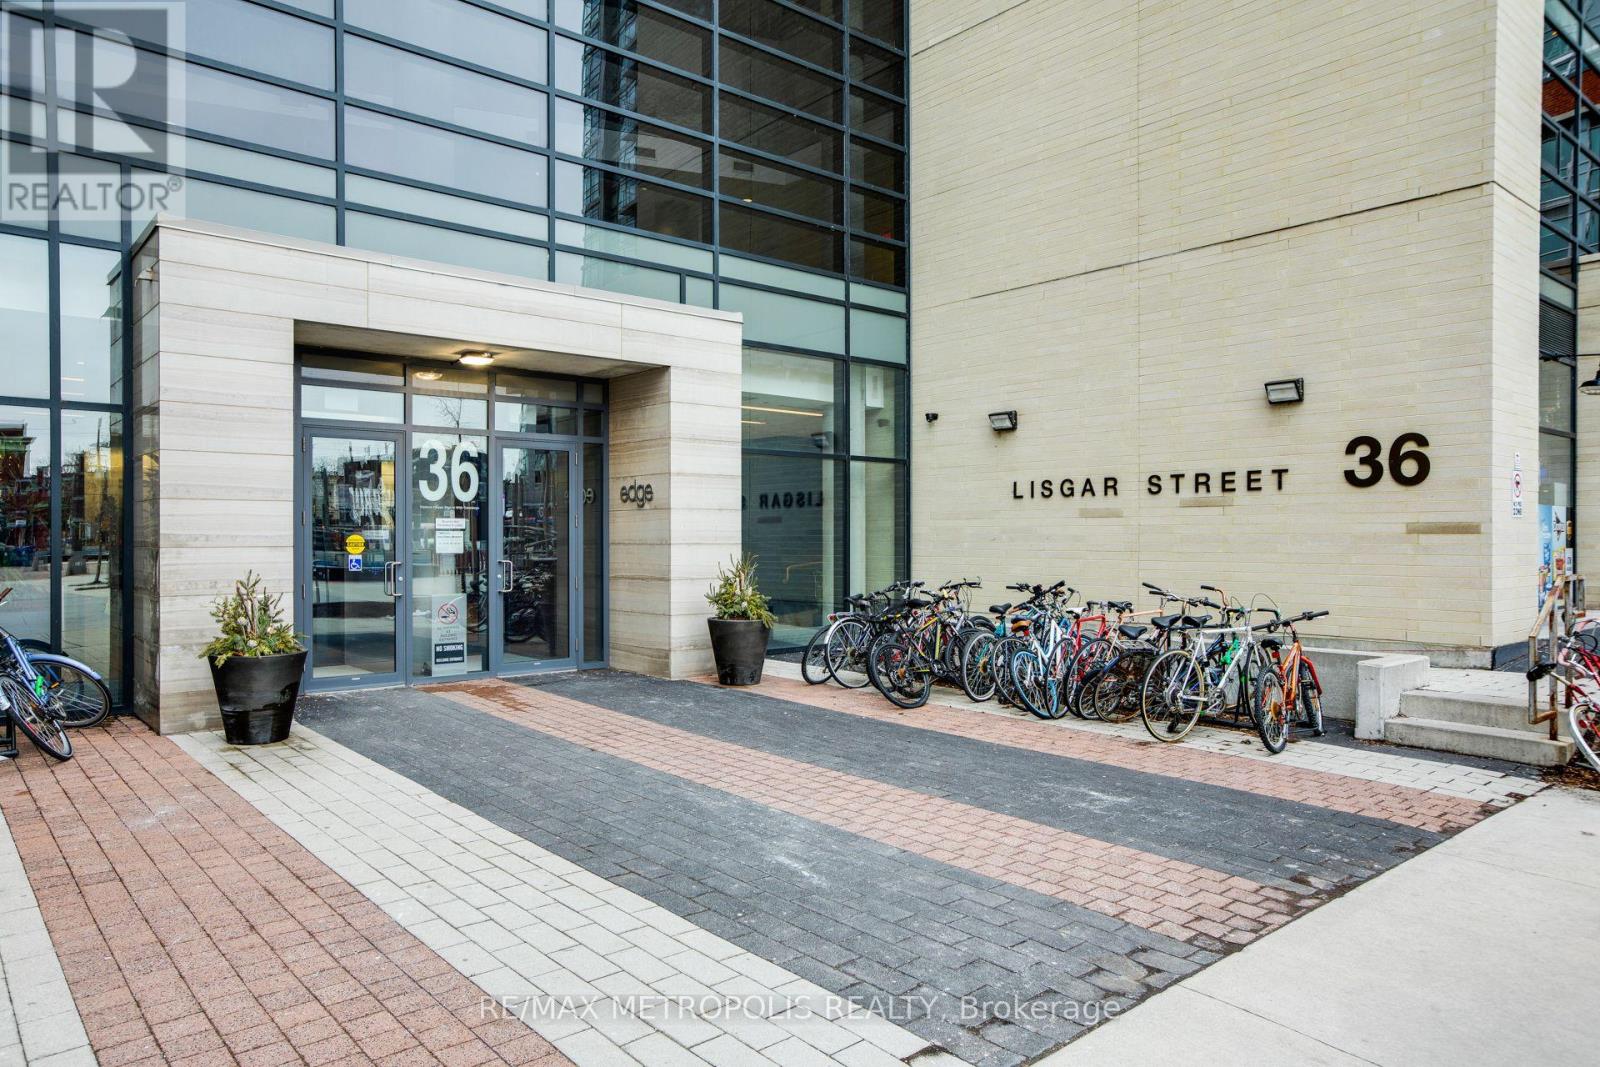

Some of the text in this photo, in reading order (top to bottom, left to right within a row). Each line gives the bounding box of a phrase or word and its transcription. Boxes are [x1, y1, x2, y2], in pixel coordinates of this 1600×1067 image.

[418, 439, 480, 502] 36
[1344, 432, 1431, 488] 36
[620, 480, 654, 509] edge
[1013, 468, 1290, 499] LISGAR STREET
